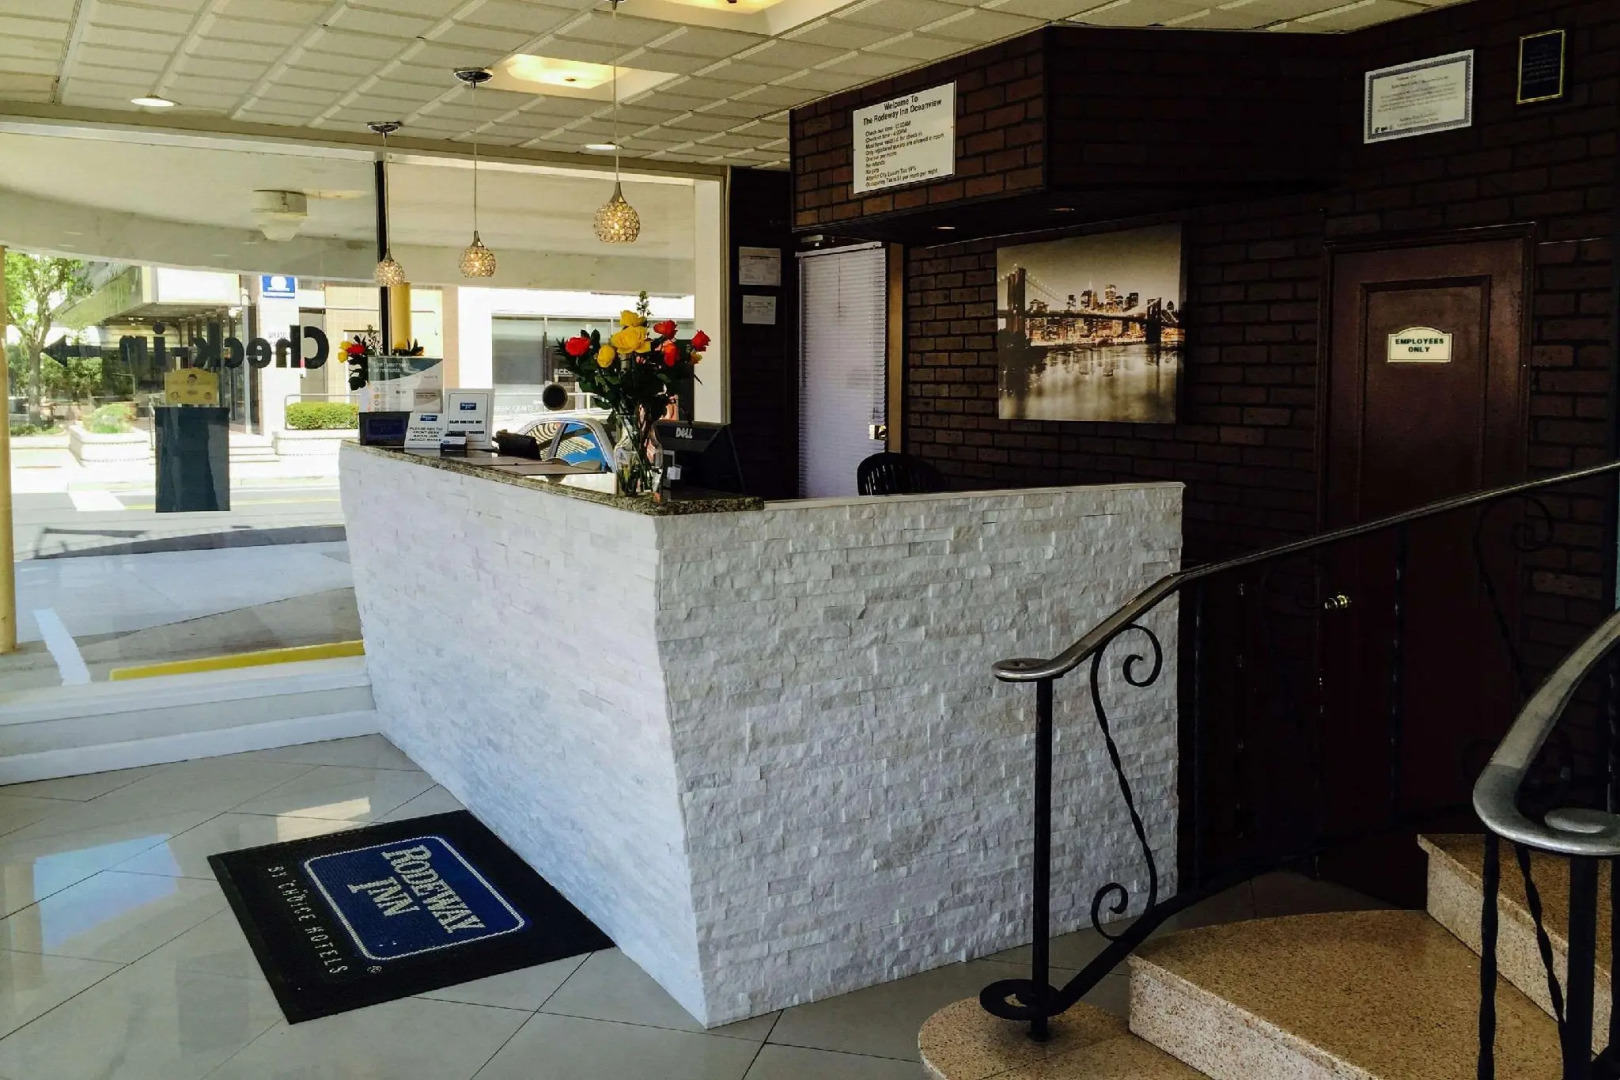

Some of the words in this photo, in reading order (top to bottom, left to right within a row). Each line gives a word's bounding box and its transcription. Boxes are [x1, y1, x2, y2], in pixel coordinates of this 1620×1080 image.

[864, 116, 873, 125] The
[874, 110, 898, 122] Rodeway
[900, 107, 908, 116] Inn
[910, 100, 941, 113] Oceanview
[884, 98, 909, 110] Welcome
[676, 427, 692, 439] DELL
[346, 876, 420, 917] INN
[381, 844, 486, 934] RODEWAY
[304, 926, 348, 974] HOTELS
